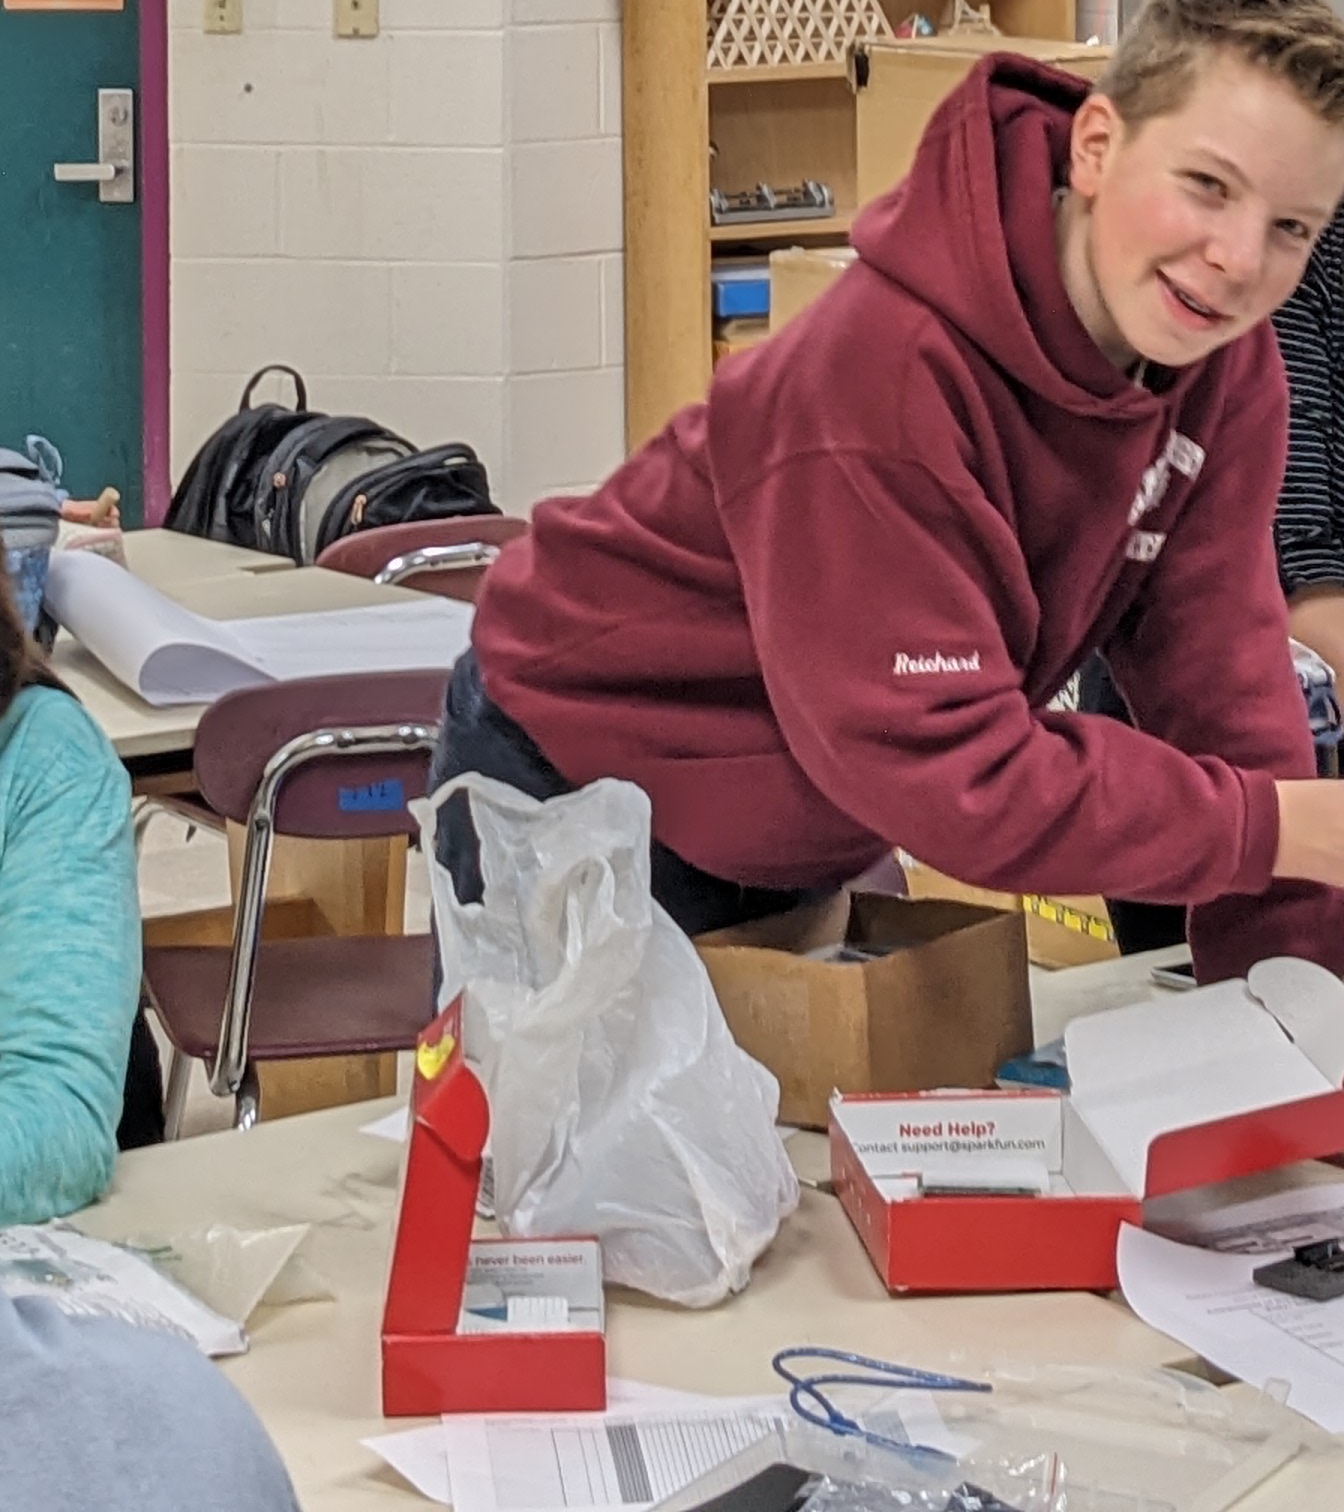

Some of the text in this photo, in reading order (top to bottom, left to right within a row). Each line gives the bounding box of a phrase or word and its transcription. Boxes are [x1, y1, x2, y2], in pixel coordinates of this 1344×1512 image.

[893, 650, 981, 676] Reichard
[899, 1122, 996, 1139] Need Help?
[901, 1138, 1046, 1154] support@sparkfun.com
[475, 1254, 509, 1267] never
[512, 1254, 545, 1266] been
